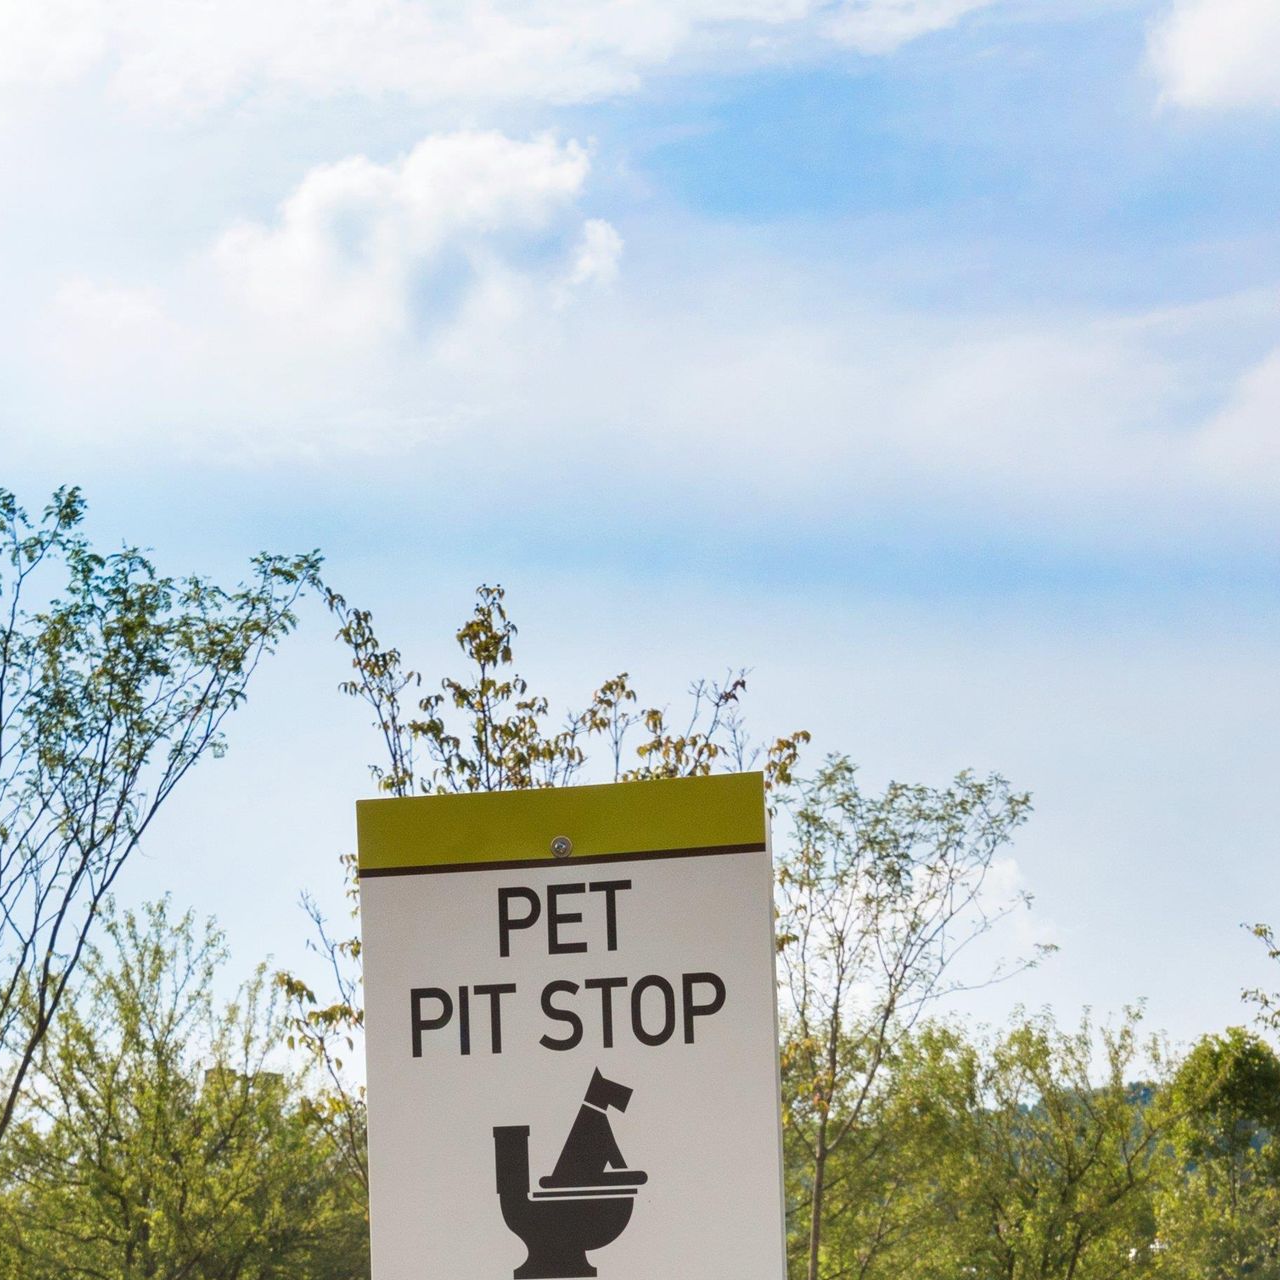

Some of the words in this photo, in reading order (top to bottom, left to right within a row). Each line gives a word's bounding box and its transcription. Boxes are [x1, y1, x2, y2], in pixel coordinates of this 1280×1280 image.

[497, 879, 632, 957] PET
[410, 983, 517, 1058] PIT
[538, 972, 727, 1052] STOP
